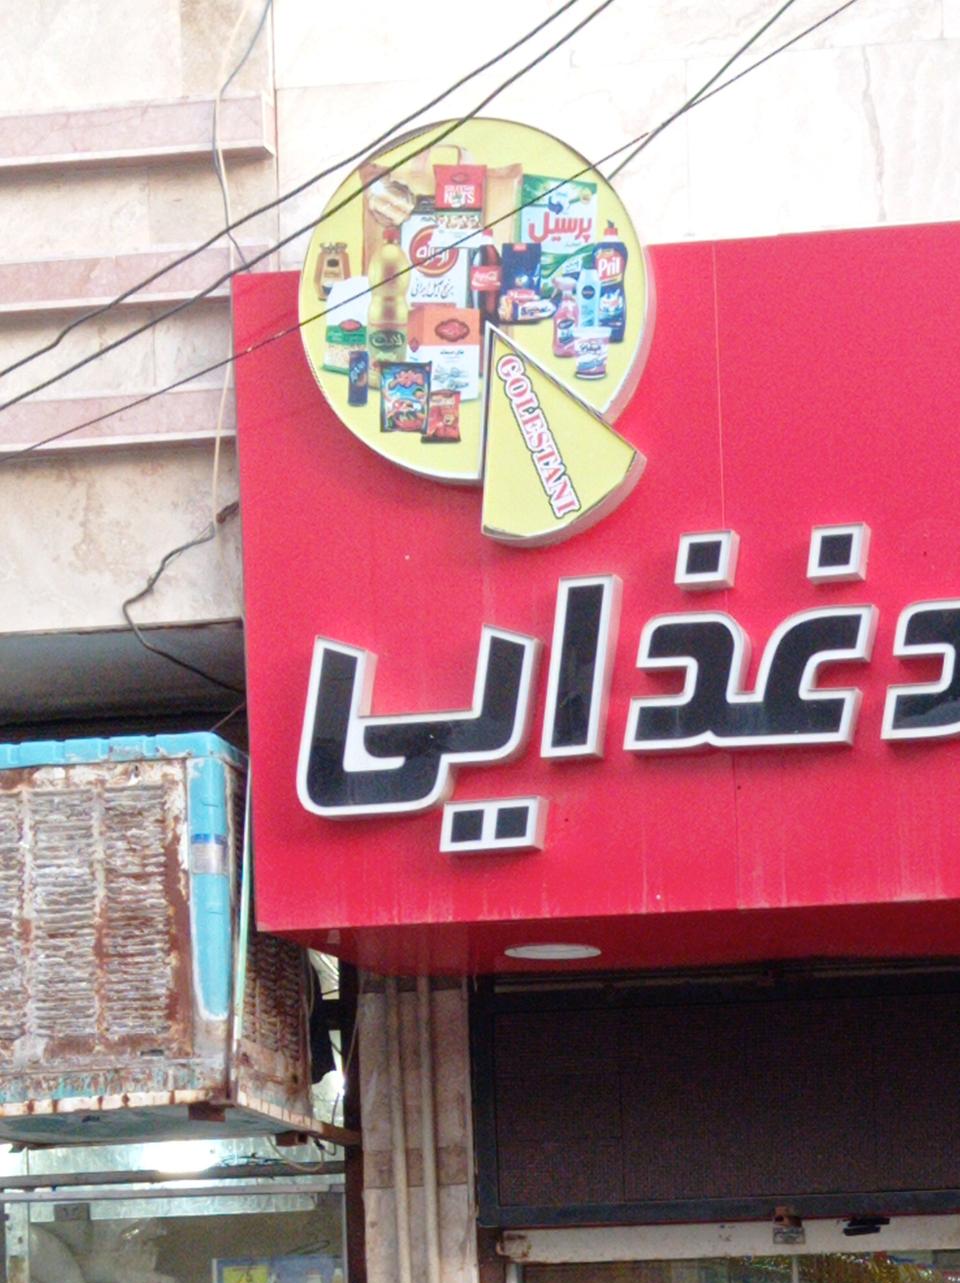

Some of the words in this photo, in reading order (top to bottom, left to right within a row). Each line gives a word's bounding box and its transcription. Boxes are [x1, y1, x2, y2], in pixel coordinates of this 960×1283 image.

[527, 211, 593, 244] پرسیل
[598, 257, 621, 277] Pril
[498, 354, 580, 518] GOLESTANI
[296, 522, 879, 853] غذایی
